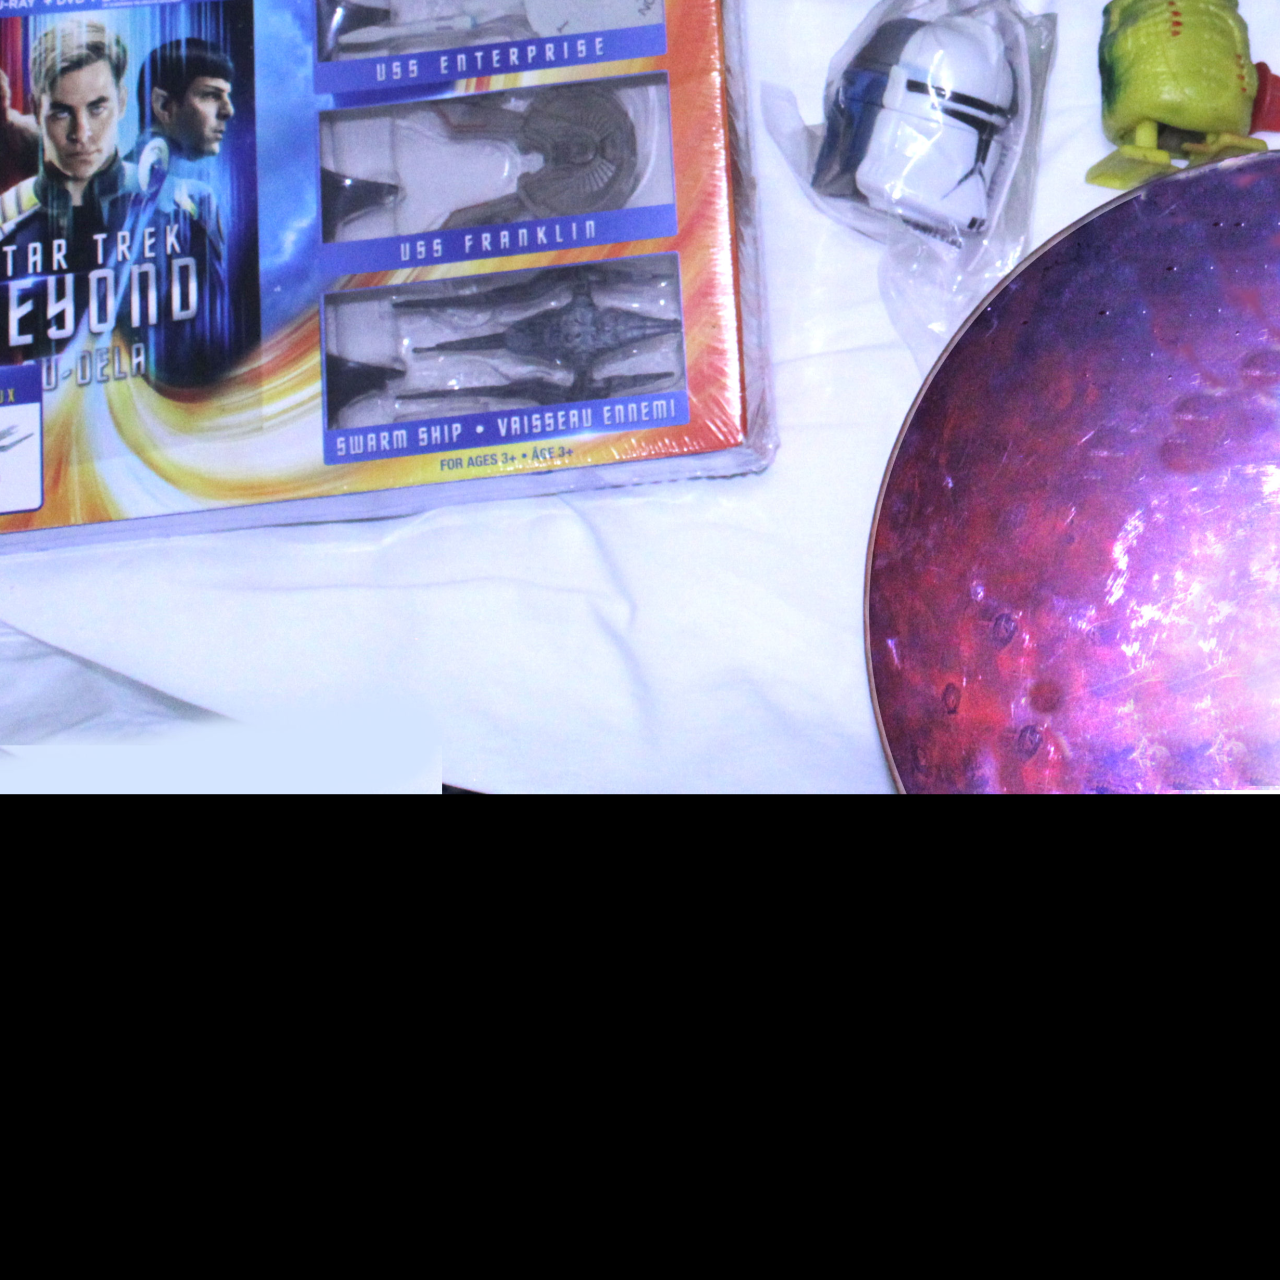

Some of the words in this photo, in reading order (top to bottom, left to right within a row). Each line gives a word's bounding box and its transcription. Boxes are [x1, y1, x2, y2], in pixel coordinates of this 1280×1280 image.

[376, 60, 418, 82] USS
[440, 37, 604, 75] ENTERPRISE
[93, 223, 182, 265] TREK
[400, 238, 443, 262] USS
[465, 220, 596, 254] FRANKLIN
[336, 429, 408, 456] SWARM
[418, 424, 462, 447] SHIP
[497, 408, 593, 438] VAISSEAU
[603, 398, 677, 425] ENNEMI
[440, 457, 464, 471] FOR
[467, 454, 499, 469] AGES
[501, 452, 518, 466] 3+
[531, 446, 555, 461] ÂGE
[557, 445, 575, 459] 3+
